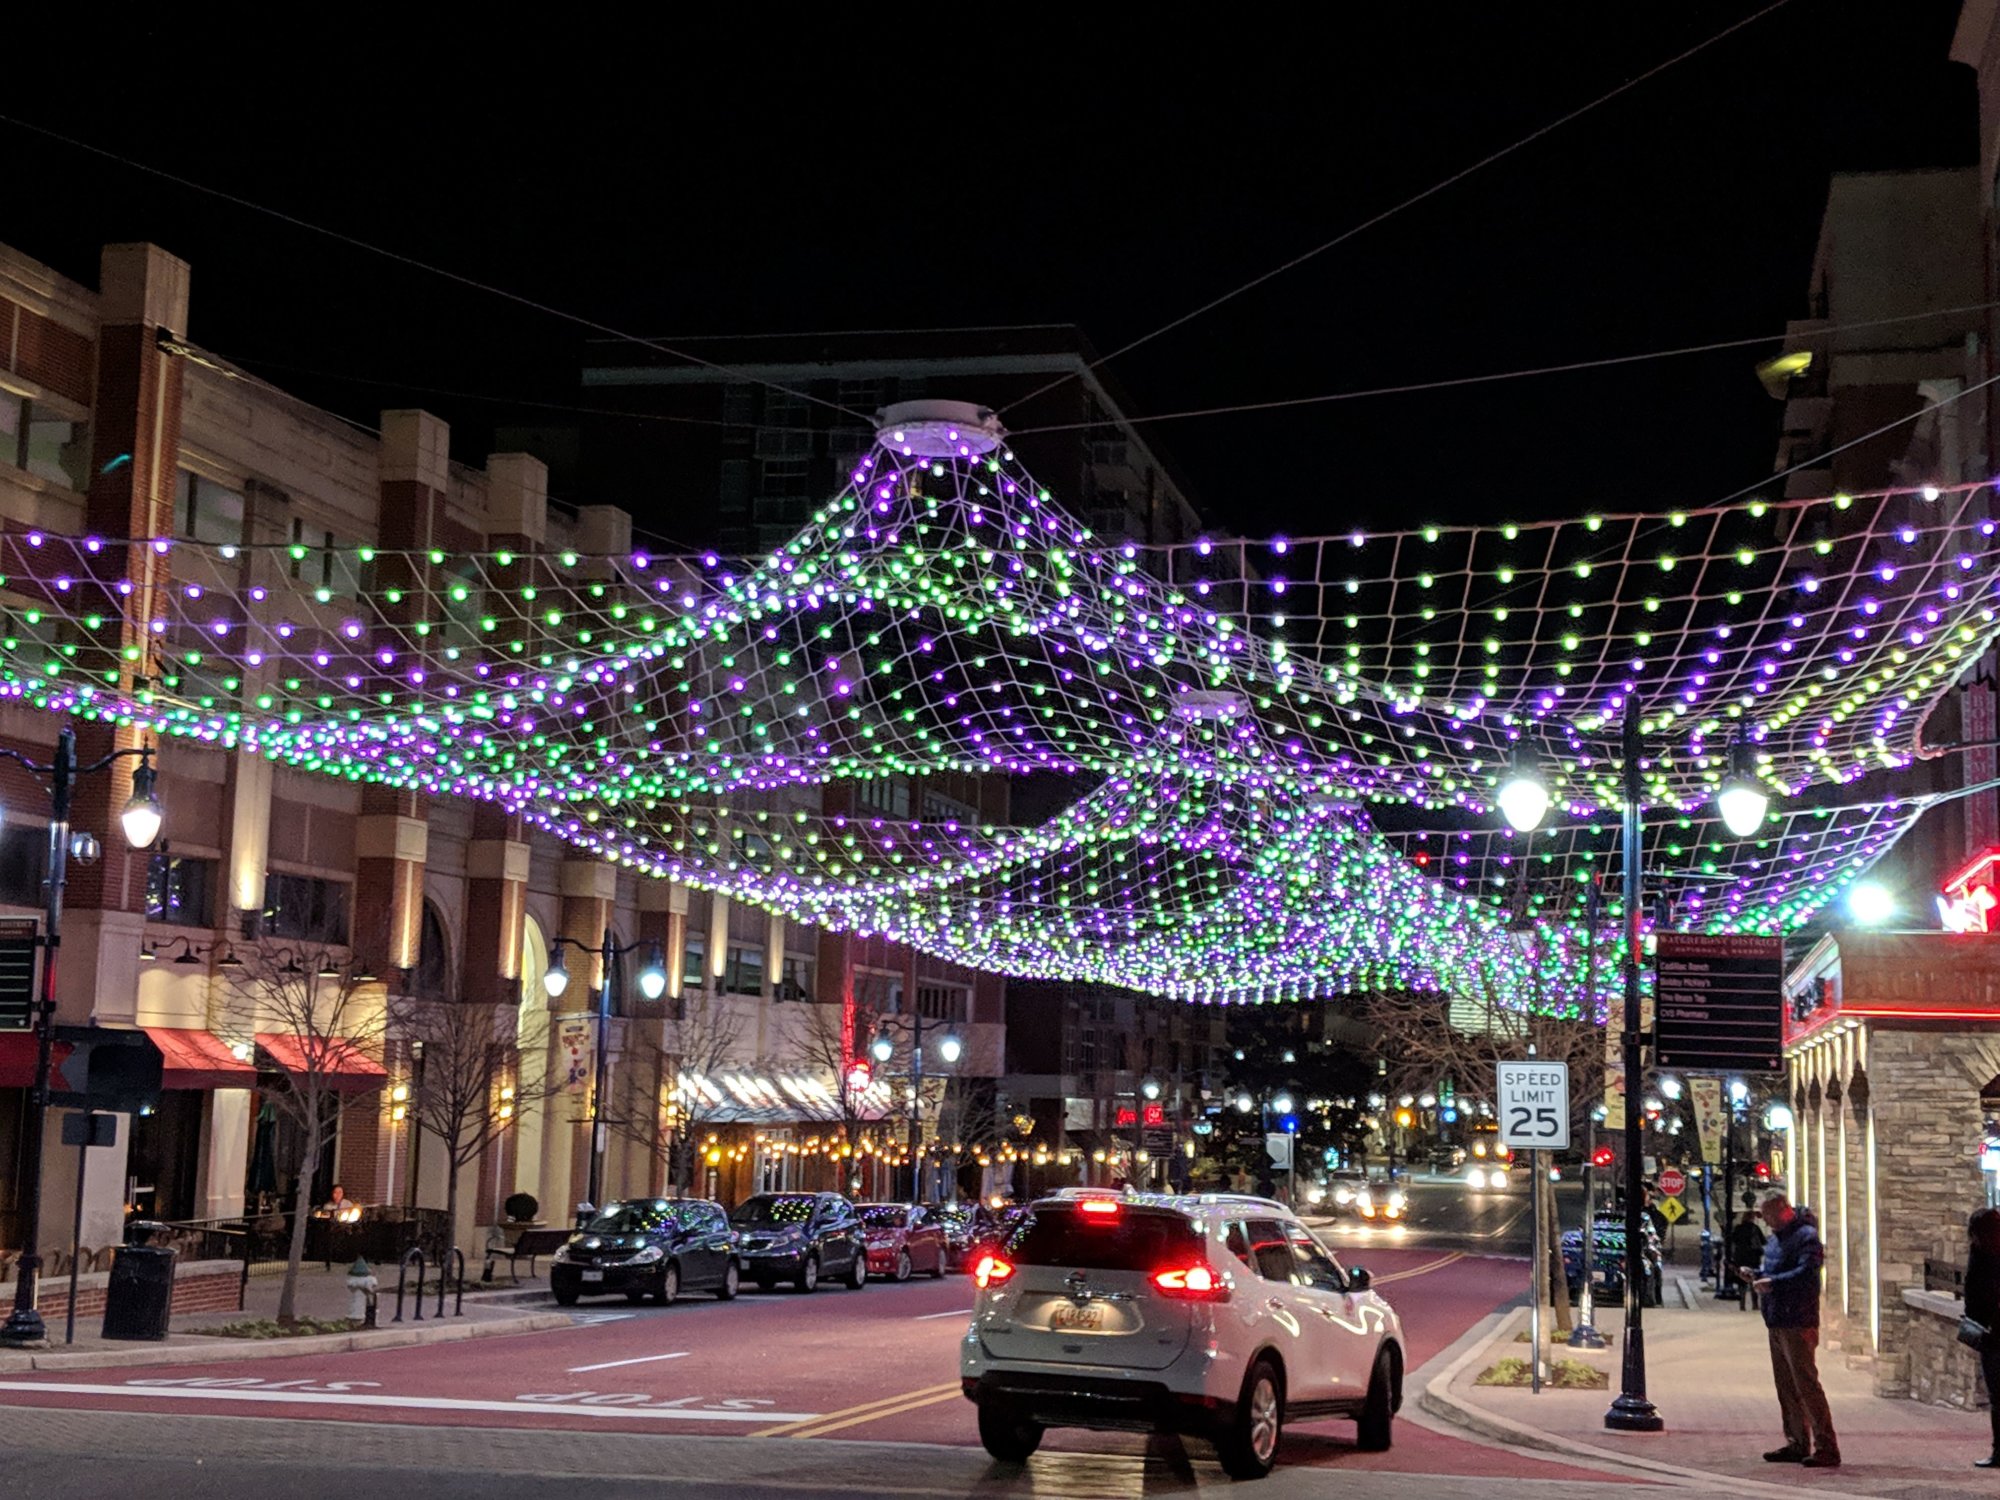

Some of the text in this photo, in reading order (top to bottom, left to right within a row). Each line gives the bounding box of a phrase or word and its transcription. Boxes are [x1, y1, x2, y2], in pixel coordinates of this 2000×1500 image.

[1660, 935, 1778, 946] WATERFRONT DISTRICT
[1660, 961, 1687, 971] Cadillac
[1660, 1008, 1675, 1018] CVS
[1676, 1009, 1709, 1019] Pharmacy
[1504, 1072, 1561, 1086] SPEED
[1511, 1090, 1555, 1103] LIMIT
[1510, 1107, 1559, 1137] 25
[1660, 1177, 1684, 1188] STOP
[515, 1391, 773, 1409] STOP
